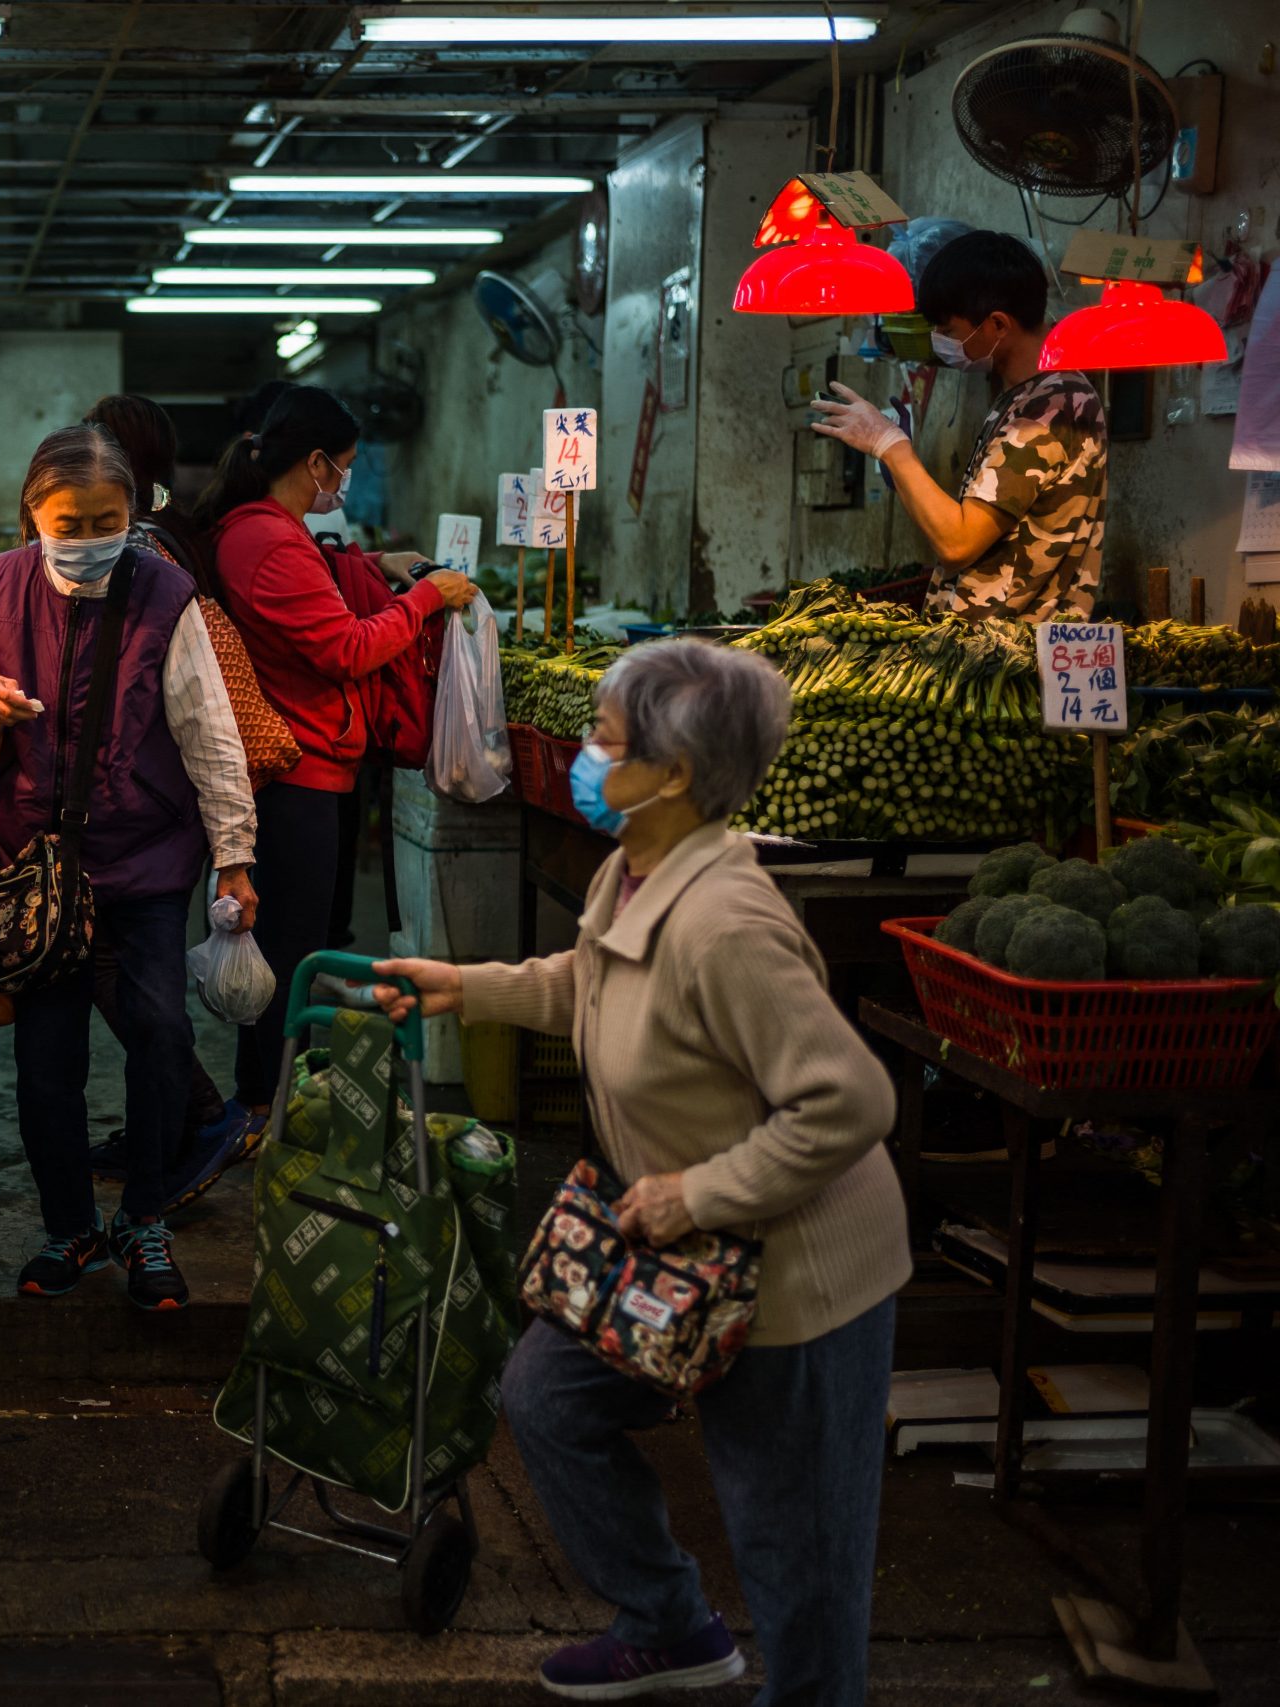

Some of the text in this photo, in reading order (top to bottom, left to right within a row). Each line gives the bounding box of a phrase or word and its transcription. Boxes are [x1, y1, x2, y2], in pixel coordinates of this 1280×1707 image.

[557, 437, 582, 466] 14
[449, 523, 470, 555] 14
[1048, 624, 1114, 644] BROCOLI
